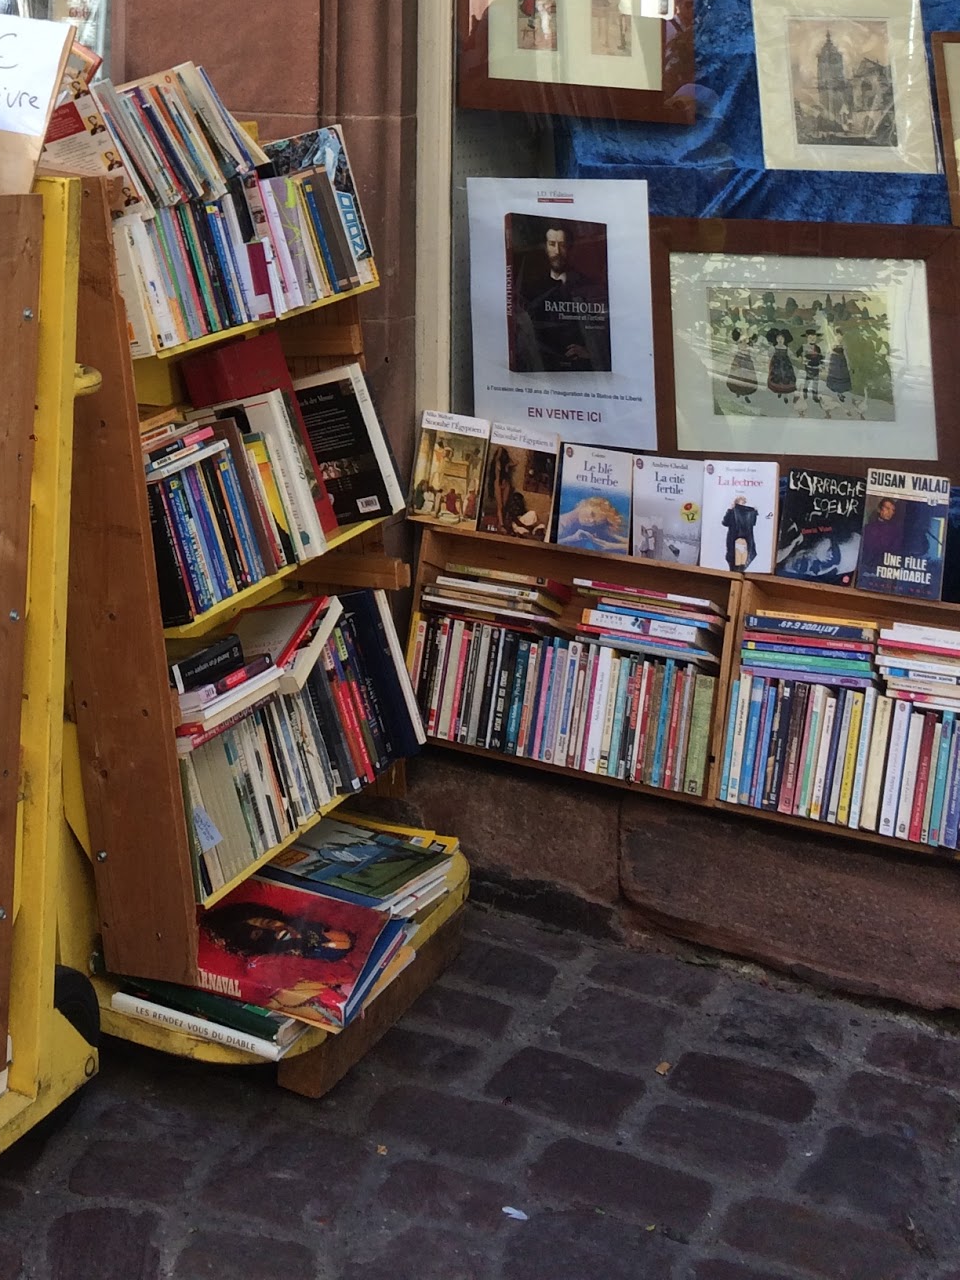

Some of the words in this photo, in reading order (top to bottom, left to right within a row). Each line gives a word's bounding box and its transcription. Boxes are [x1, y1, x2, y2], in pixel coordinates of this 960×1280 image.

[544, 300, 607, 314] BARTHOLDI
[528, 407, 543, 419] EN
[546, 408, 584, 422] VENTE
[587, 412, 602, 423] ICI
[583, 460, 596, 472] Le
[597, 462, 613, 475] blé
[576, 473, 589, 482] en
[590, 473, 619, 487] herbe
[655, 471, 666, 482] La
[668, 472, 685, 484] cité
[718, 475, 730, 487] La
[731, 476, 764, 488] lectrice
[870, 471, 906, 489] SUSAN
[911, 476, 950, 494] VIALAD
[656, 482, 684, 495] fertile
[883, 552, 902, 568] UNE
[904, 554, 928, 572] FILLE
[876, 566, 932, 585] FORMIDABLE
[134, 1006, 150, 1017] LES
[151, 1011, 183, 1028] RENDEZ
[186, 1022, 209, 1036] VOUS
[211, 1030, 224, 1041] DU
[225, 1034, 256, 1051] DIABLE
